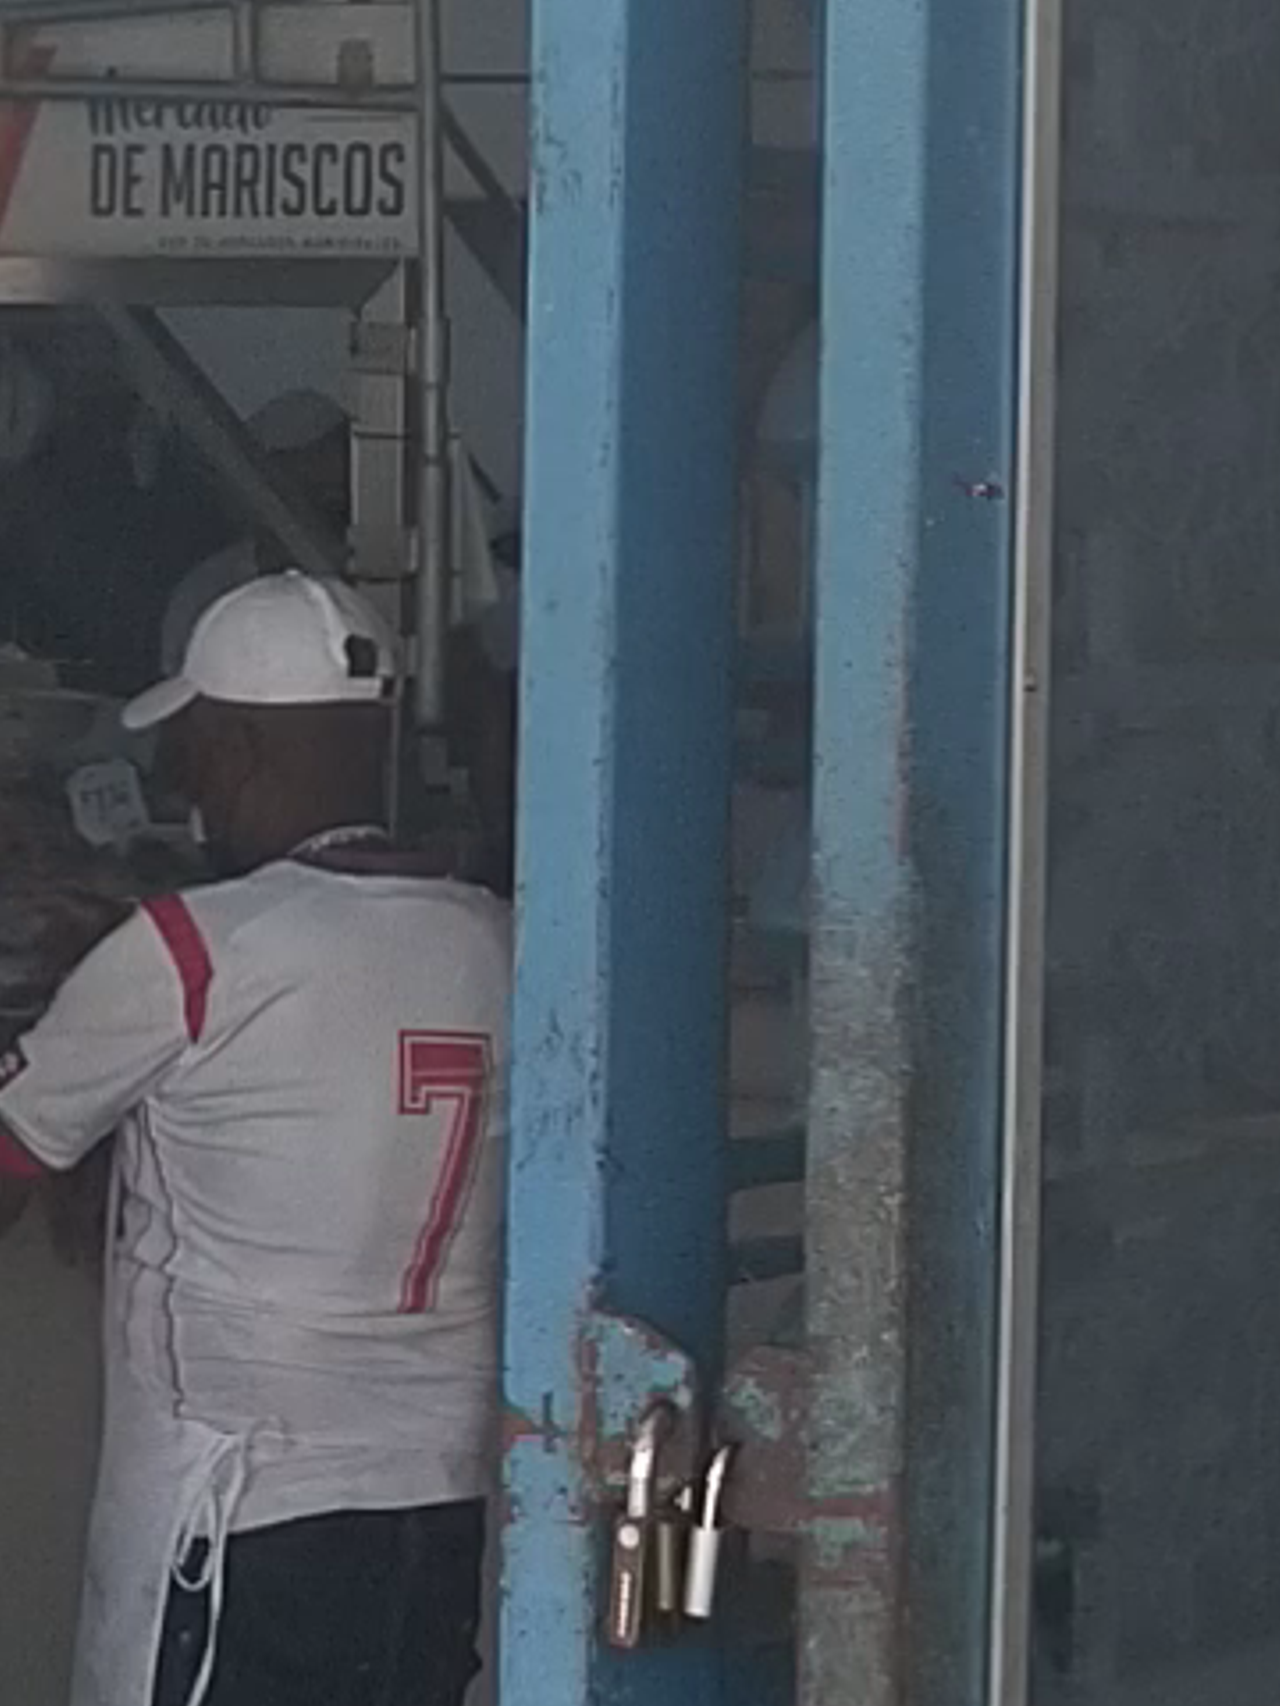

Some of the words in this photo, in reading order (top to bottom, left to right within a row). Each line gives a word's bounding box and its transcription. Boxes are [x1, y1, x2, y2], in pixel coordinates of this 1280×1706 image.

[90, 143, 147, 218] DE
[158, 141, 406, 218] MARISCOS
[397, 1029, 493, 1314] 7
